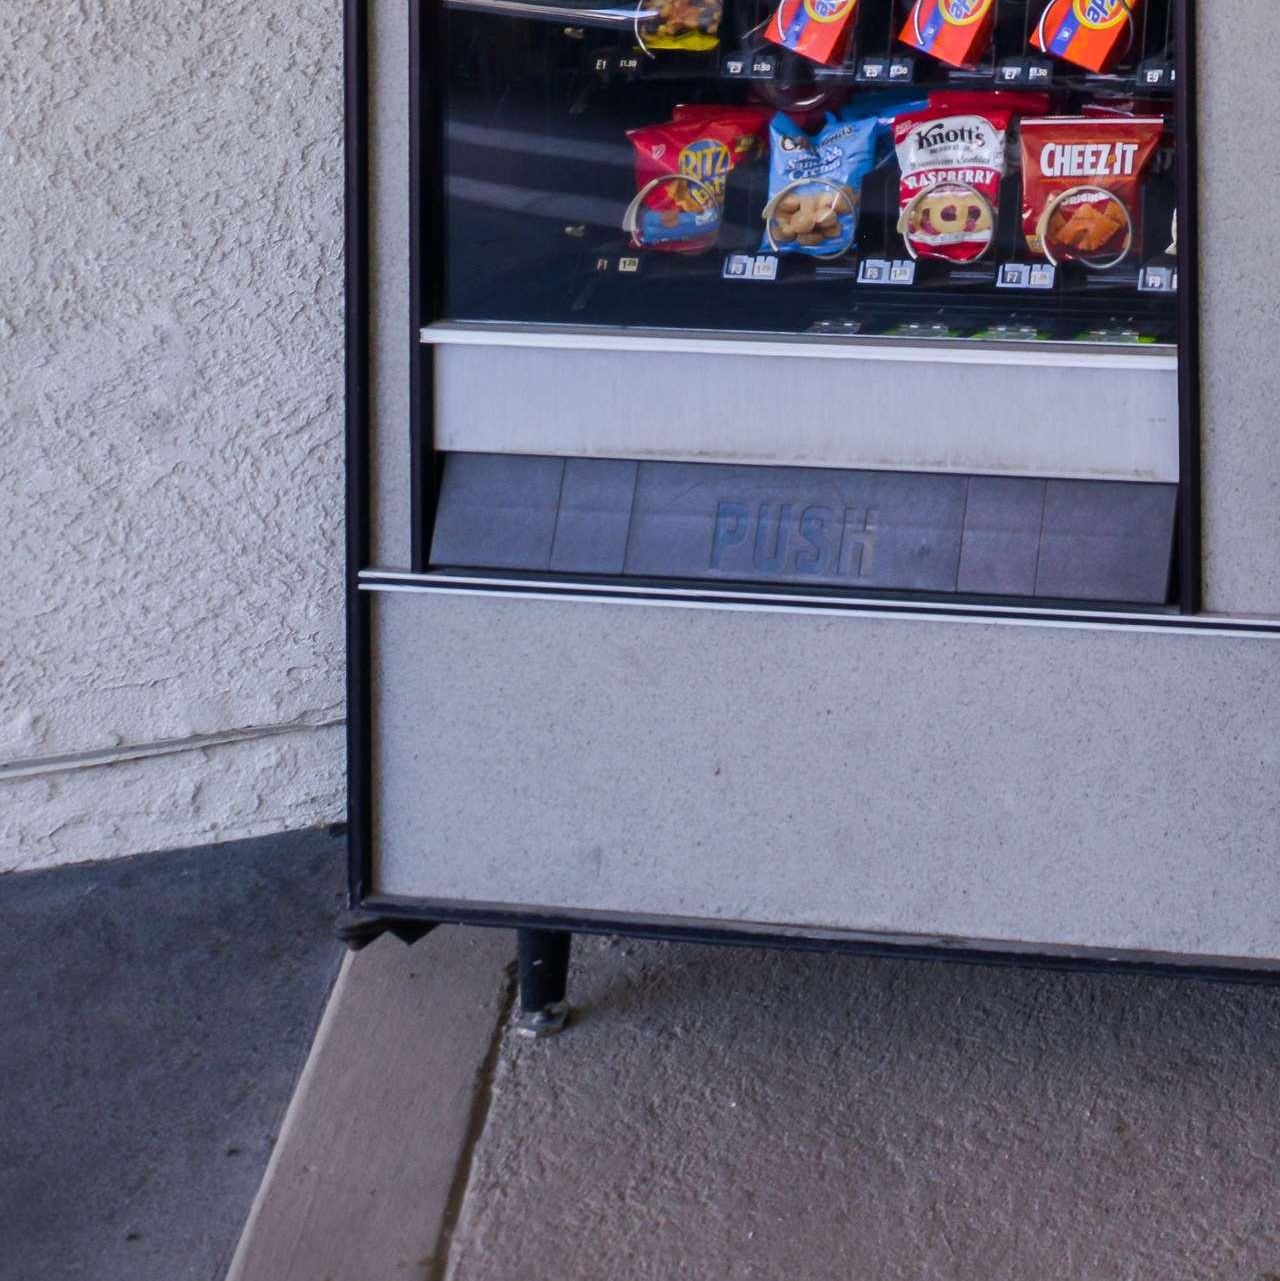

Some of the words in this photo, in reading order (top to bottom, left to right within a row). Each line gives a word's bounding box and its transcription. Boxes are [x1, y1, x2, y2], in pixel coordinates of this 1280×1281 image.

[595, 59, 606, 69] E1
[1005, 69, 1016, 79] E7
[1147, 71, 1159, 82] E9
[916, 122, 986, 150] Knott's
[680, 146, 728, 178] RITZ
[904, 169, 995, 190] RASPBERRY
[1006, 271, 1018, 283] F7
[709, 501, 878, 577] PUSH
